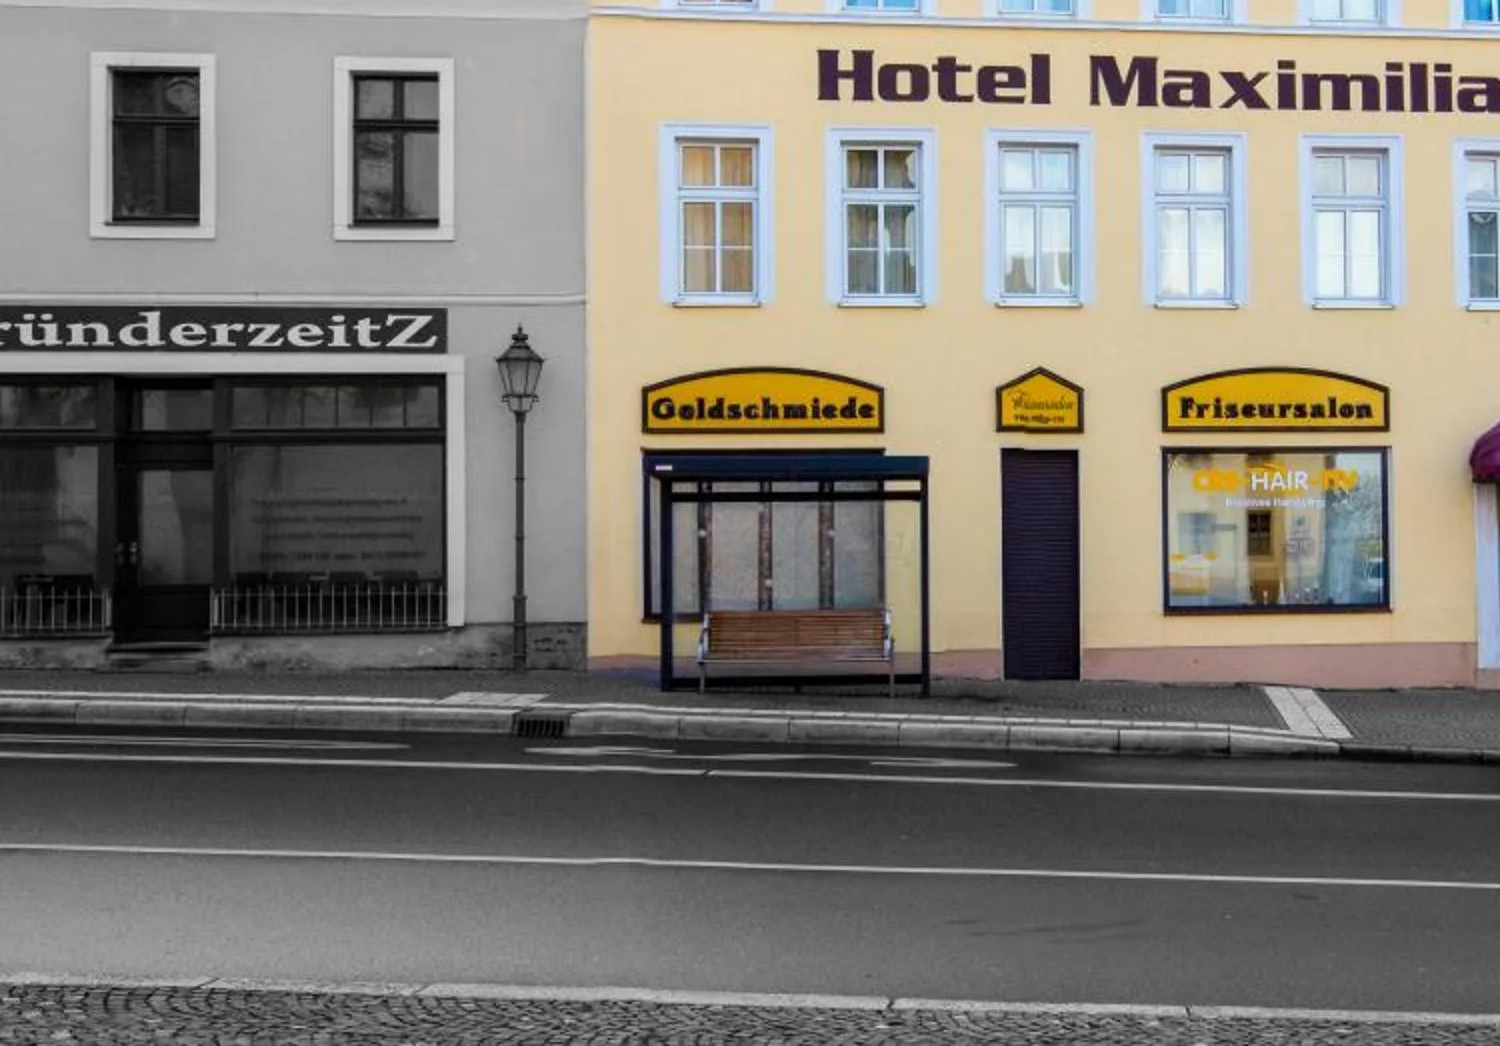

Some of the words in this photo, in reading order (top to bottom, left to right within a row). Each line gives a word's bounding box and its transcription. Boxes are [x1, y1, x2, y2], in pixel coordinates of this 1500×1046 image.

[817, 49, 1052, 106] Hotel
[651, 396, 876, 421] Goldschmiede
[1179, 395, 1374, 419] Friseursalon
